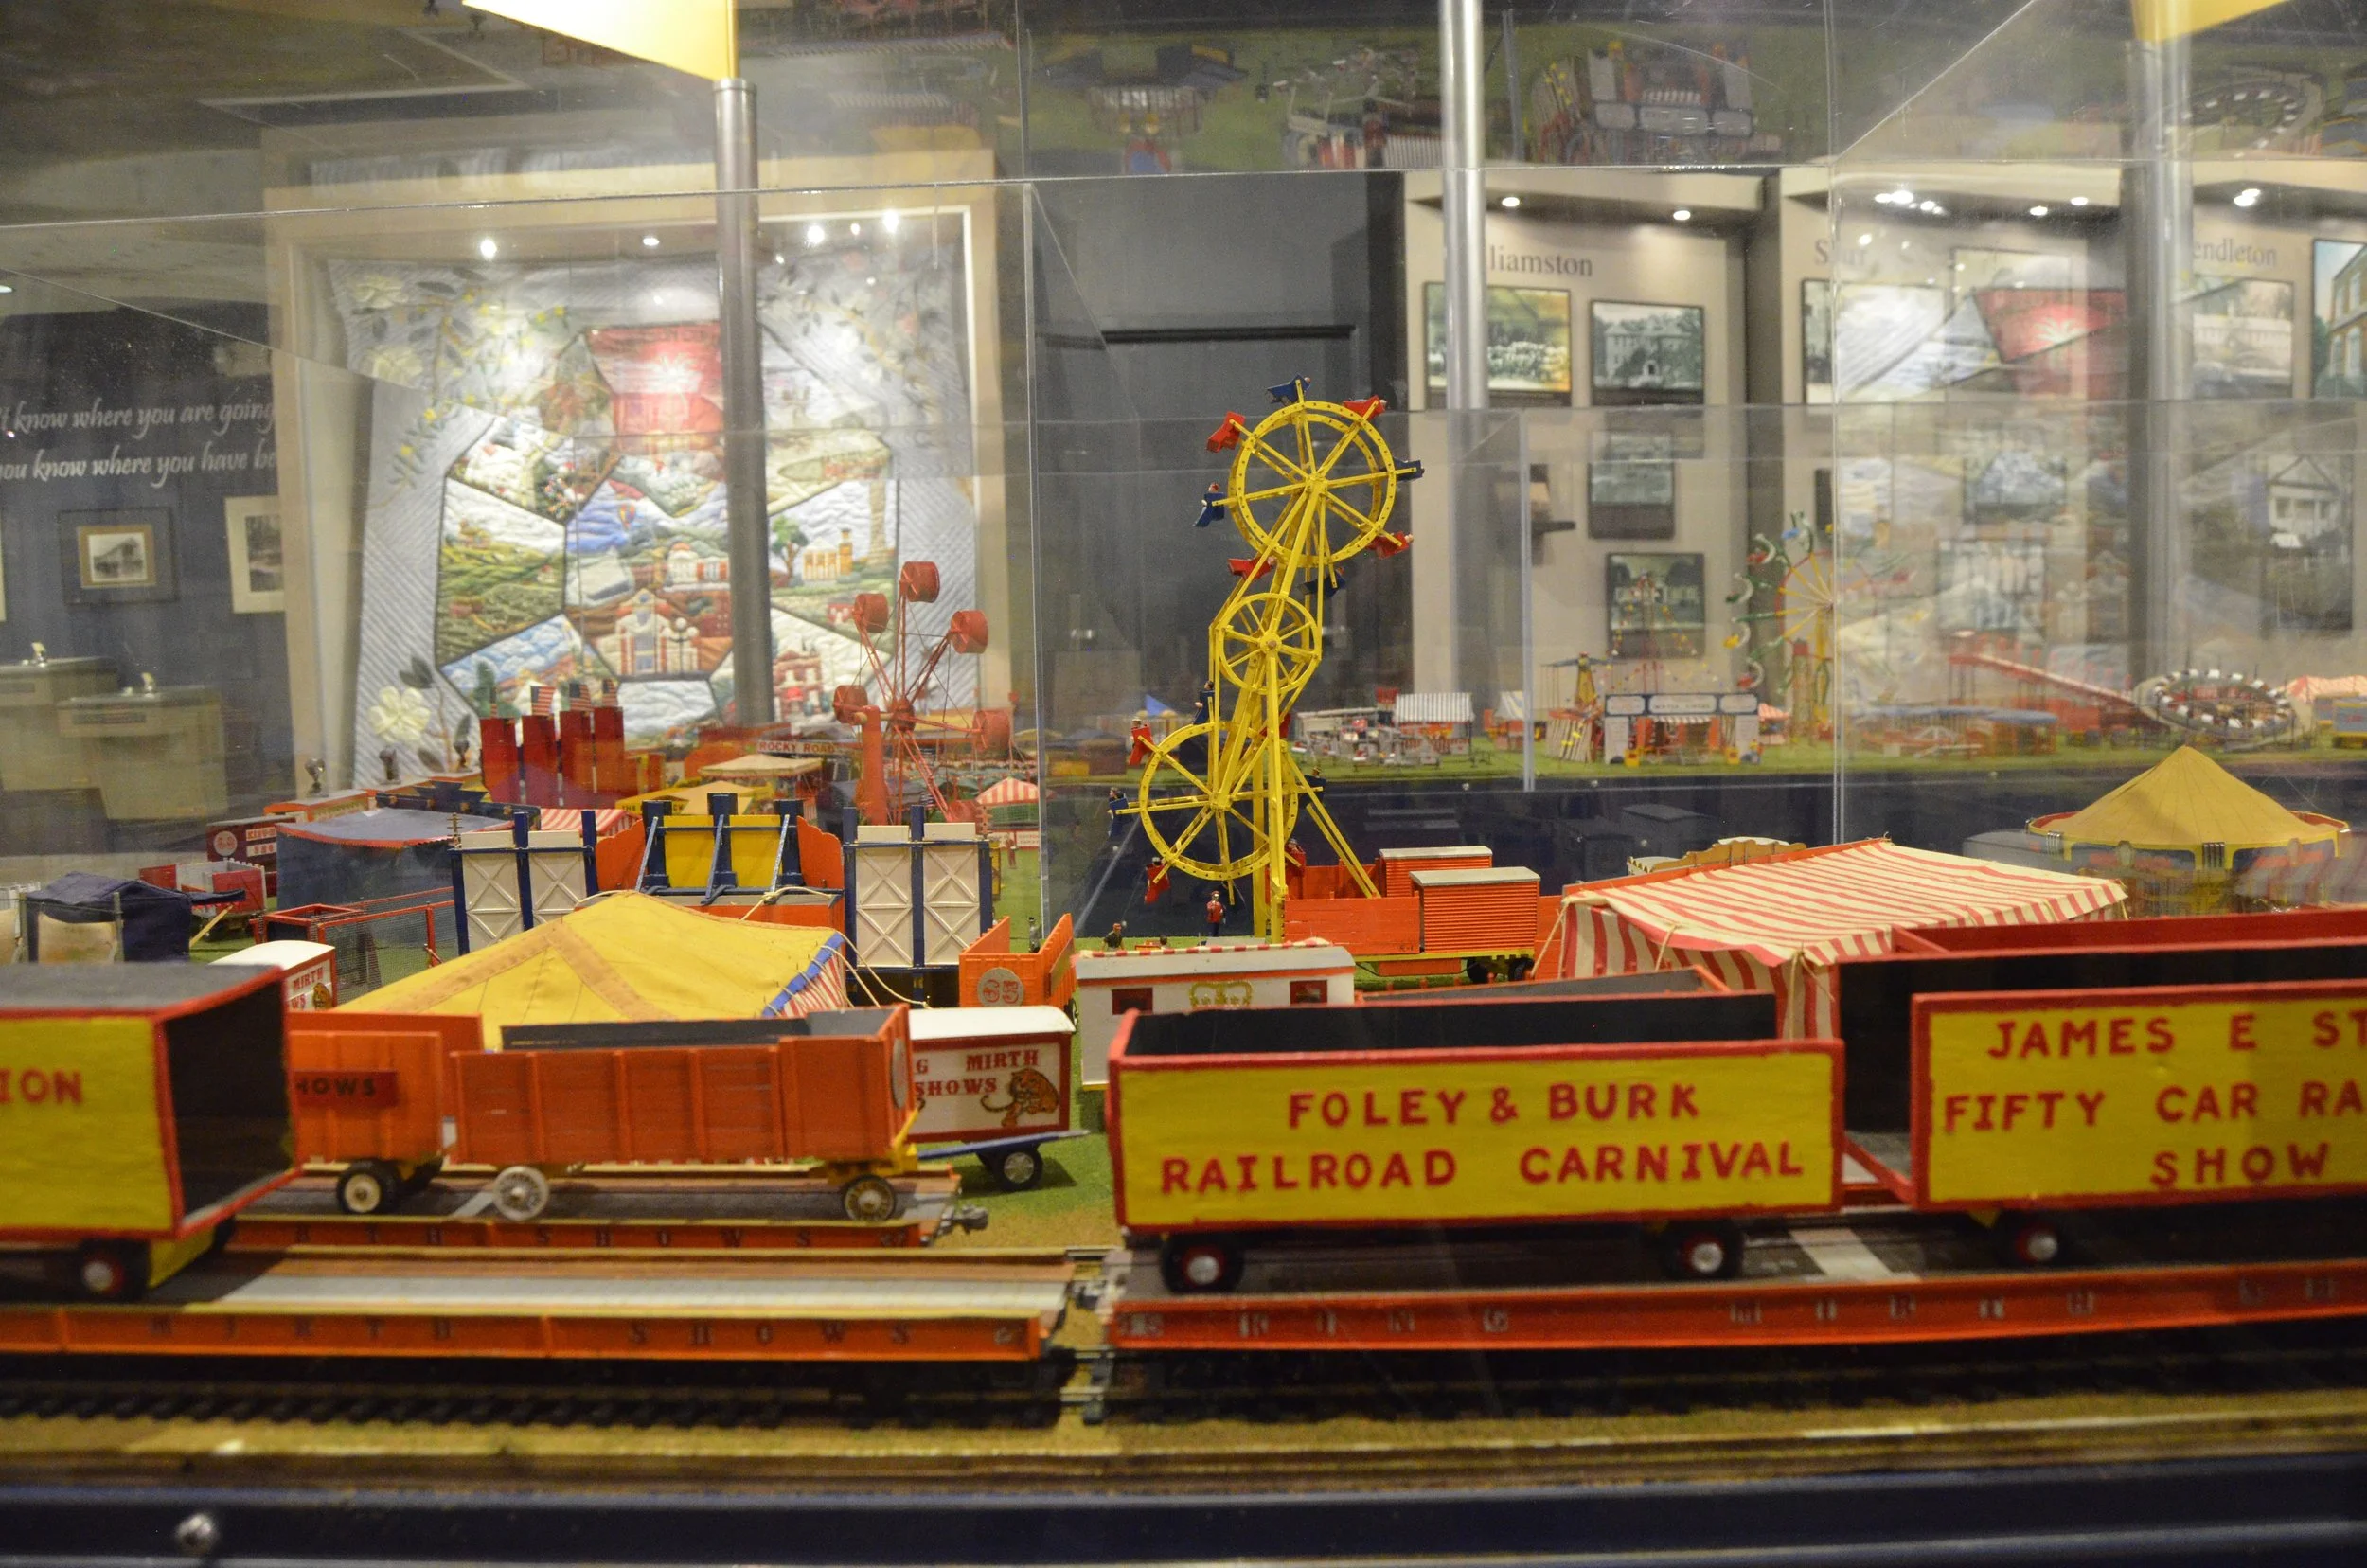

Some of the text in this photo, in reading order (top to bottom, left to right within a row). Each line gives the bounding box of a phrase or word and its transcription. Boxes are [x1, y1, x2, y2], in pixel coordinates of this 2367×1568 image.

[1488, 244, 1593, 276] liamston
[2195, 238, 2277, 266] endleton
[13, 401, 68, 434] know
[72, 397, 133, 428] where
[131, 408, 175, 439] you
[180, 404, 214, 423] are
[0, 438, 276, 488] ou know where you have be
[758, 741, 836, 754] ROCKY ROAD
[982, 979, 1020, 1004] 65
[1988, 1010, 2367, 1060] JAMES E ST
[914, 1049, 1040, 1076] G MIRTH
[0, 1066, 84, 1106] ION
[296, 1077, 376, 1098] HOWS
[915, 1078, 998, 1097] SHOWS
[1289, 1082, 1700, 1130] FOLEY & BURK
[1944, 1078, 2366, 1134] FIFTY CAR RA
[1161, 1141, 1804, 1195] RAILROAD CARNIVAL
[2150, 1142, 2329, 1188] SHOW
